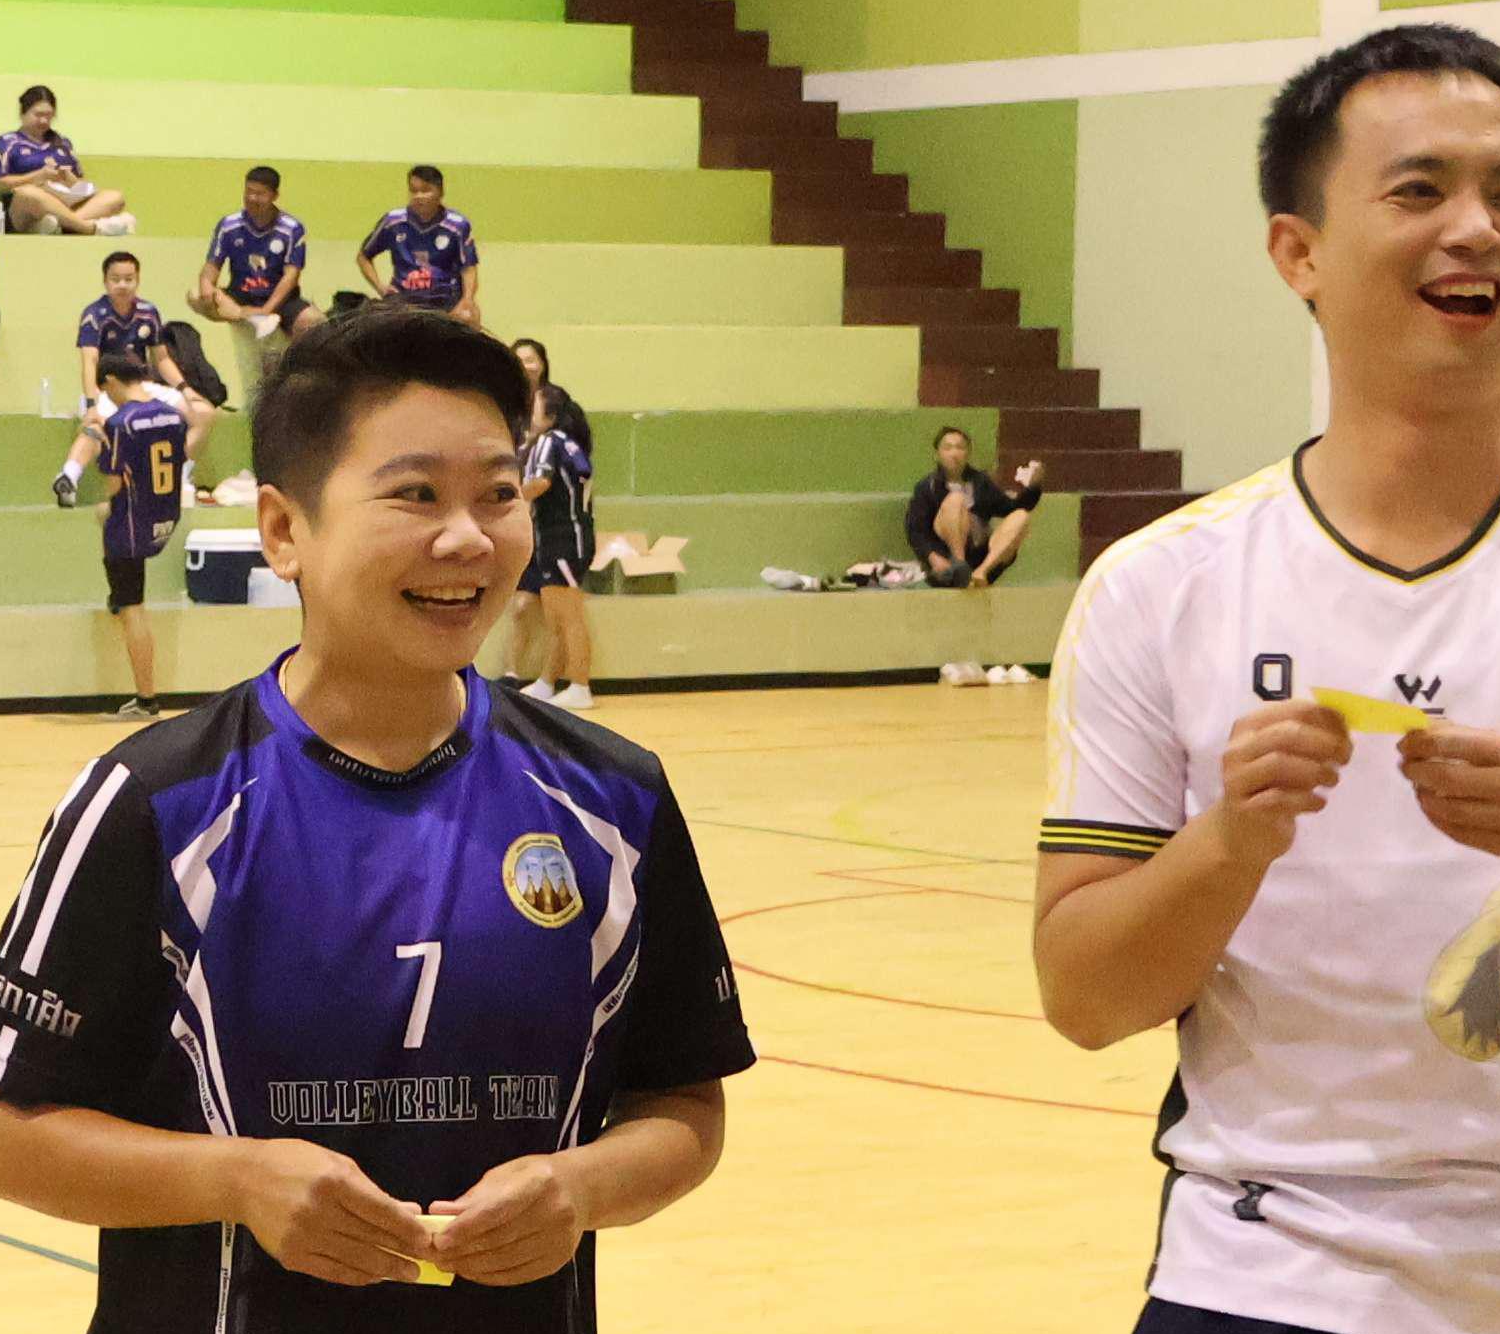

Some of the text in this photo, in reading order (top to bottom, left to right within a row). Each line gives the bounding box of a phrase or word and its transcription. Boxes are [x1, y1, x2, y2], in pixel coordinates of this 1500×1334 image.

[150, 440, 175, 496] 6
[395, 941, 443, 1049] 7
[268, 1076, 478, 1125] VOLLEYBALL
